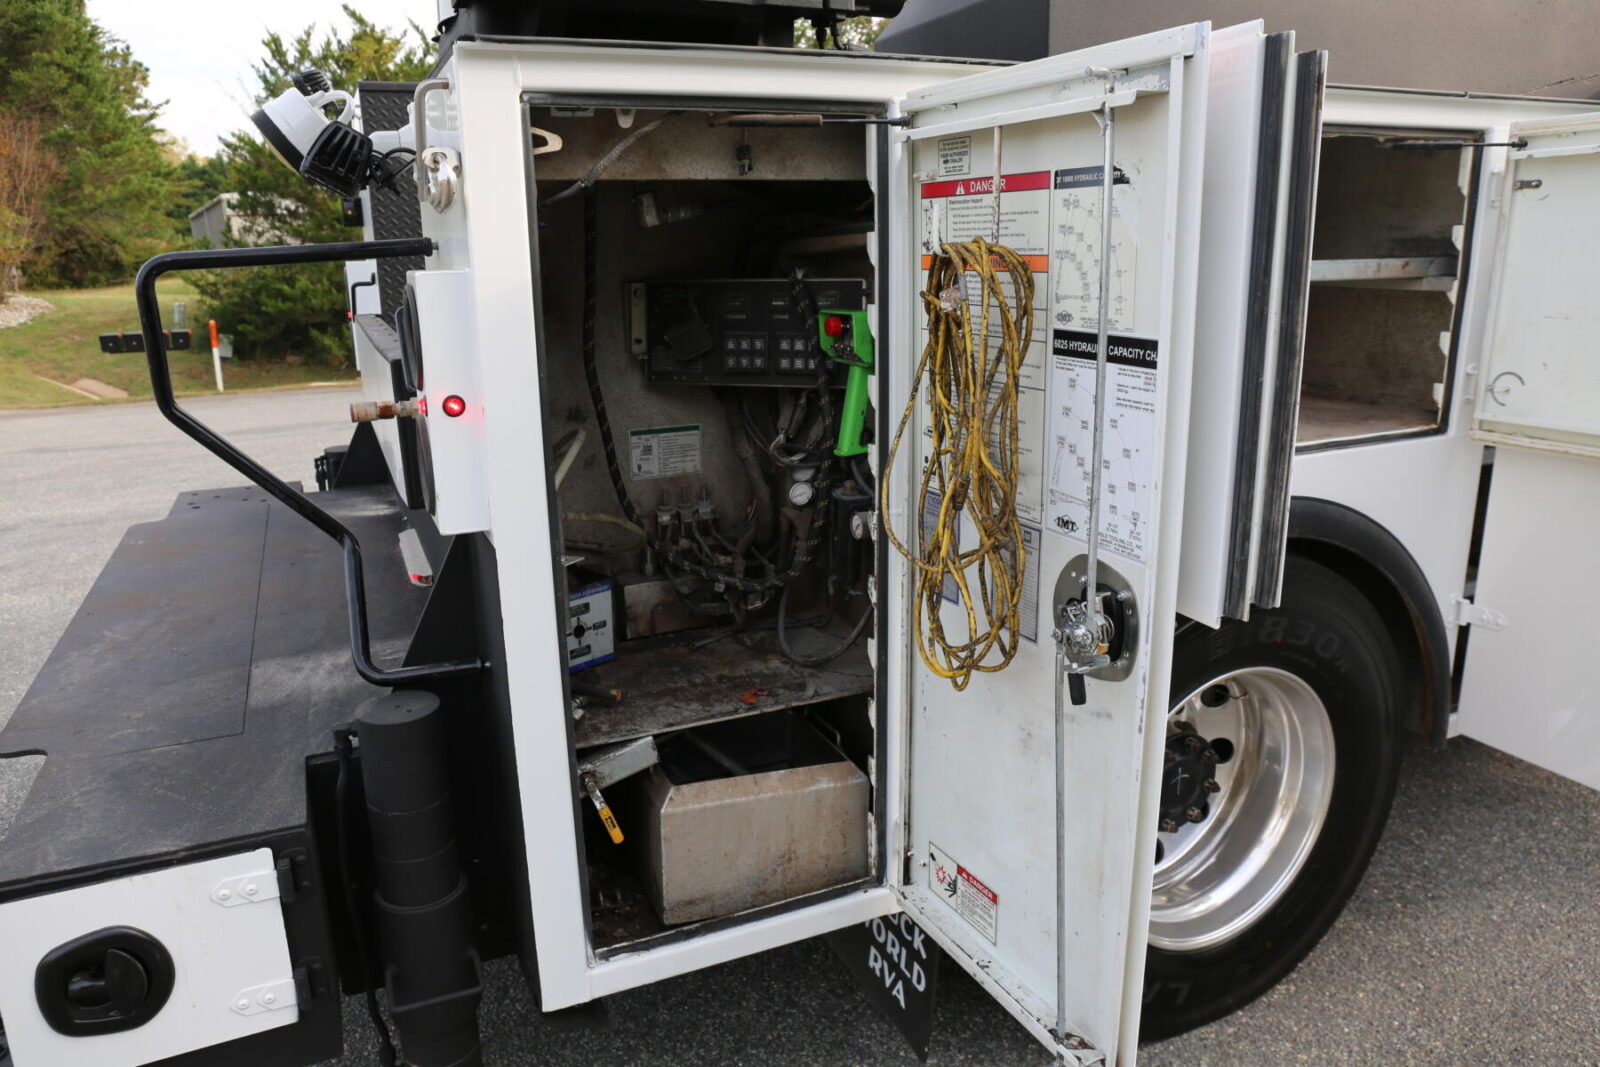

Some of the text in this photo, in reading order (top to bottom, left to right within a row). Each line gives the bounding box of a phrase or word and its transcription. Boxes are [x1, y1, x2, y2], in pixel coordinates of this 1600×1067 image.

[970, 178, 1007, 193] DANGR
[1054, 339, 1068, 349] 6025
[1108, 345, 1144, 359] CAPACITY
[1057, 516, 1076, 532] IMT
[969, 876, 993, 899] DANGER
[865, 918, 926, 992] ORLD
[869, 945, 905, 1010] RVA
